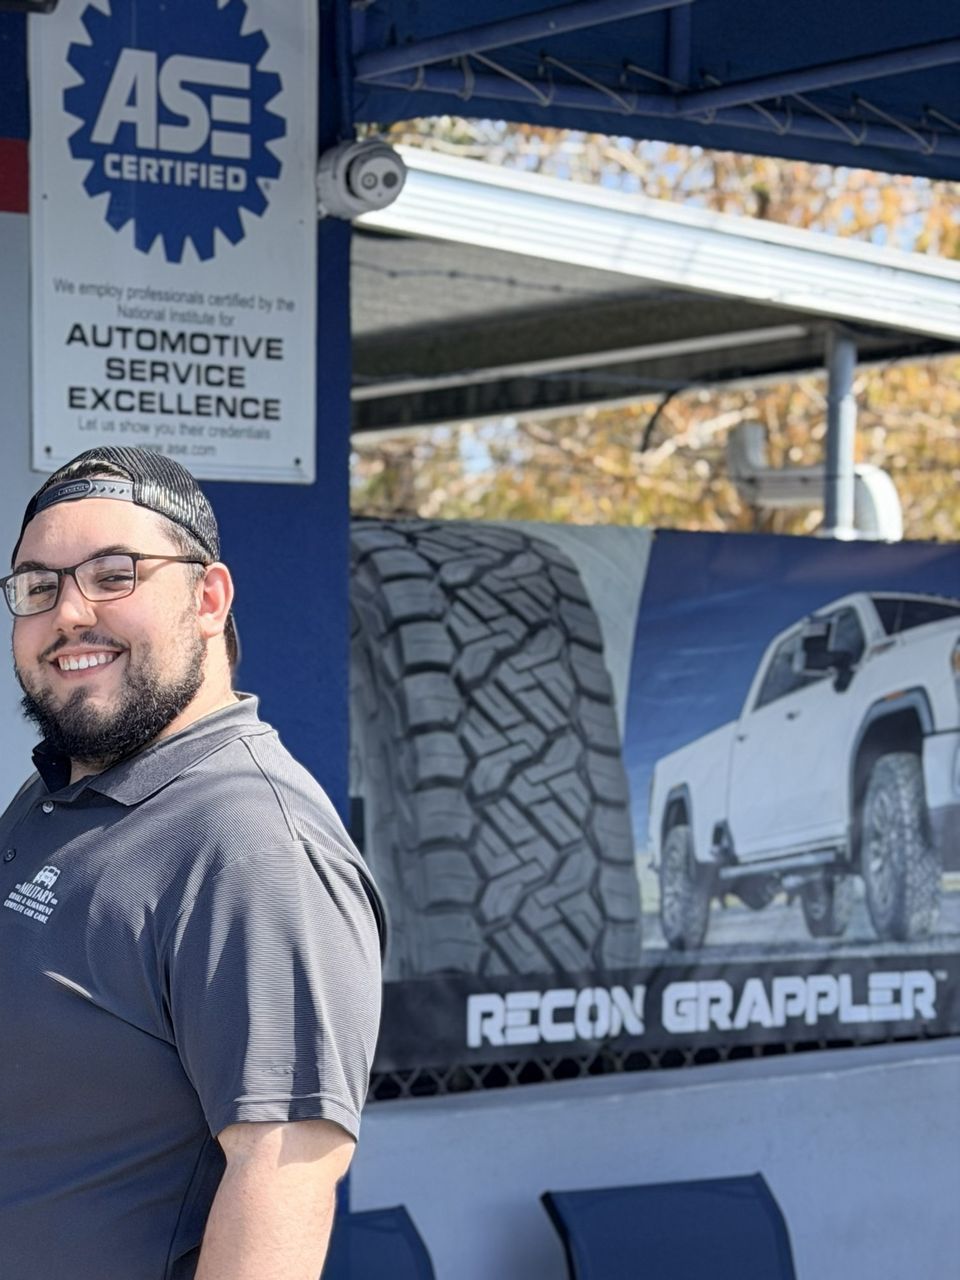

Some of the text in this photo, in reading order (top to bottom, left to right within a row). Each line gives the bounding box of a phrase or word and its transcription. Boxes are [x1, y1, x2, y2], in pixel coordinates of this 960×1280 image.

[90, 47, 251, 159] ASE
[104, 153, 247, 191] CERTIFIED
[53, 278, 295, 313] We employ professionals certified by the
[117, 304, 236, 327] National Institute for
[66, 323, 284, 360] AUTOMOTIVE
[105, 357, 246, 389] SERVICE
[67, 387, 282, 421] EXCELLENCE
[78, 416, 271, 440] Let us show you their credentials
[18, 882, 55, 904] MILITARY
[466, 970, 937, 1048] RECON GRAPPLER
